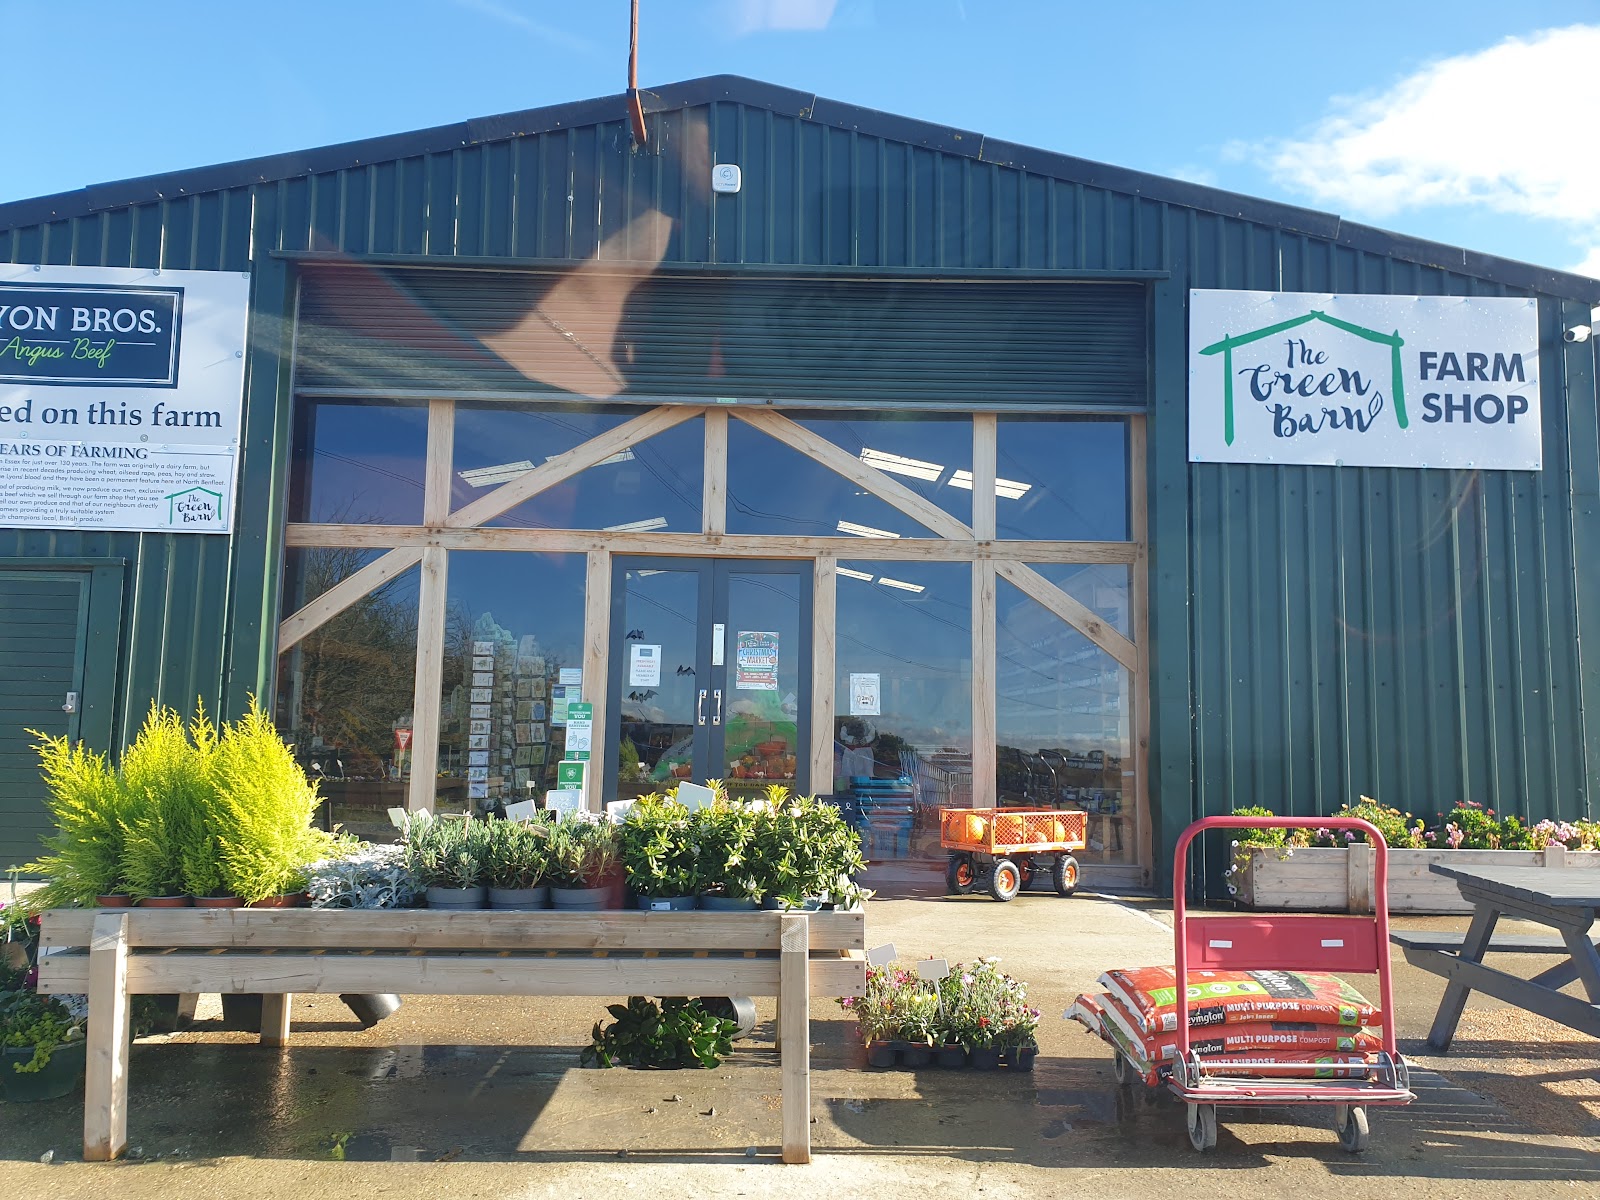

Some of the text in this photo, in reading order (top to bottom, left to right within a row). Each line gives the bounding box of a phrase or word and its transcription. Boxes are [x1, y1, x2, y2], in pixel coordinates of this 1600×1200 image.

[70, 307, 162, 333] BROS.
[0, 336, 117, 369] Angus Beef
[1284, 339, 1329, 369] The
[1419, 351, 1526, 382] FARM
[1238, 364, 1371, 401] Green
[0, 399, 222, 428] ed on this farm
[1265, 393, 1379, 438] Barn
[1421, 393, 1529, 424] SHOP
[0, 444, 148, 459] EARS OF FARMING
[174, 502, 212, 512] Green
[182, 510, 215, 522] Barn
[1226, 1003, 1254, 1012] MULTI
[1256, 1002, 1300, 1011] PURPOSE
[1226, 1035, 1253, 1044] MULTI
